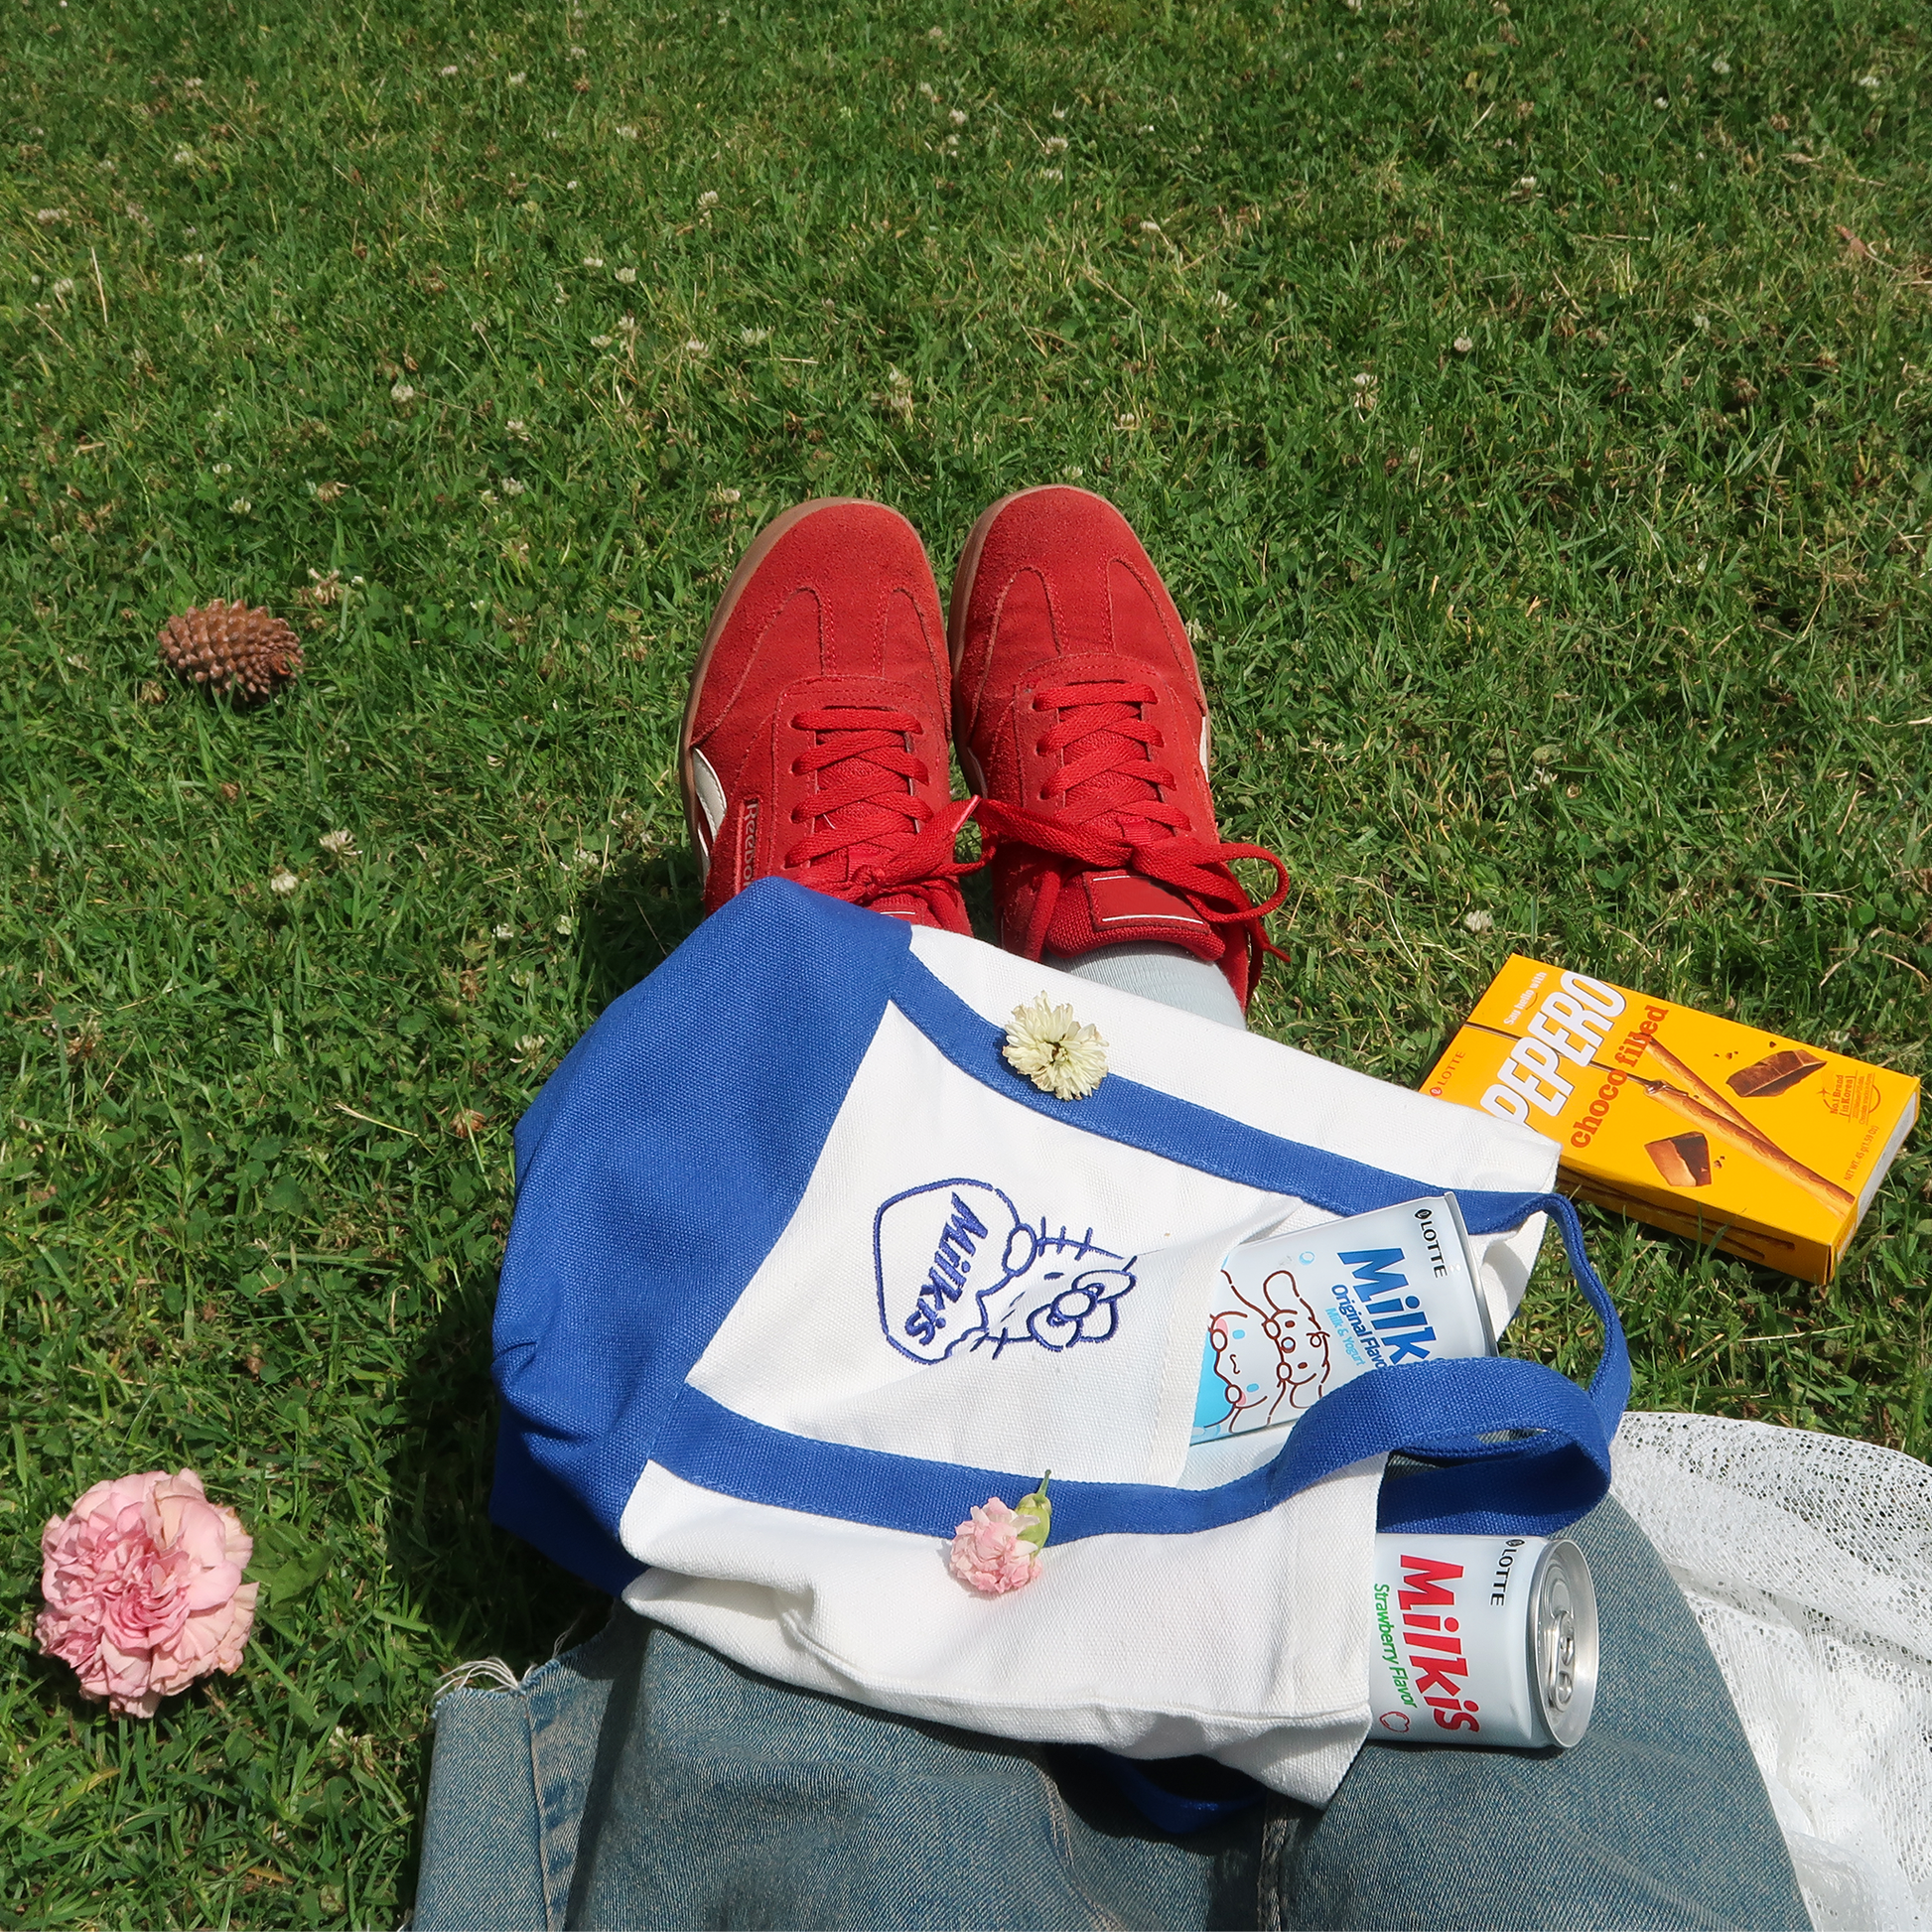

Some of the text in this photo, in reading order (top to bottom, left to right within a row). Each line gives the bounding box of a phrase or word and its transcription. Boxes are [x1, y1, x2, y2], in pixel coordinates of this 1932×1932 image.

[1514, 989, 1535, 1010] hello
[1530, 971, 1548, 991] with
[1437, 1050, 1466, 1086] LOTTE
[1479, 970, 1627, 1134] PEPERO
[1570, 1005, 1670, 1149] choco filled
[1833, 1074, 1845, 1098] Brand
[1841, 1078, 1854, 1105] Korea
[1844, 1167, 1855, 1181] NET
[1849, 1157, 1862, 1170] WT.
[1855, 1150, 1864, 1161] 45
[904, 1191, 988, 1345] Milkis
[1420, 1221, 1448, 1279] LOTTE
[1331, 1284, 1373, 1337] Original
[1336, 1247, 1443, 1365] Milk
[1324, 1307, 1366, 1366] Milk & Yogurt
[1490, 1549, 1517, 1606] LOTTE
[1373, 1584, 1418, 1709] Strawberry Flavor
[1397, 1554, 1480, 1732] Milkis
